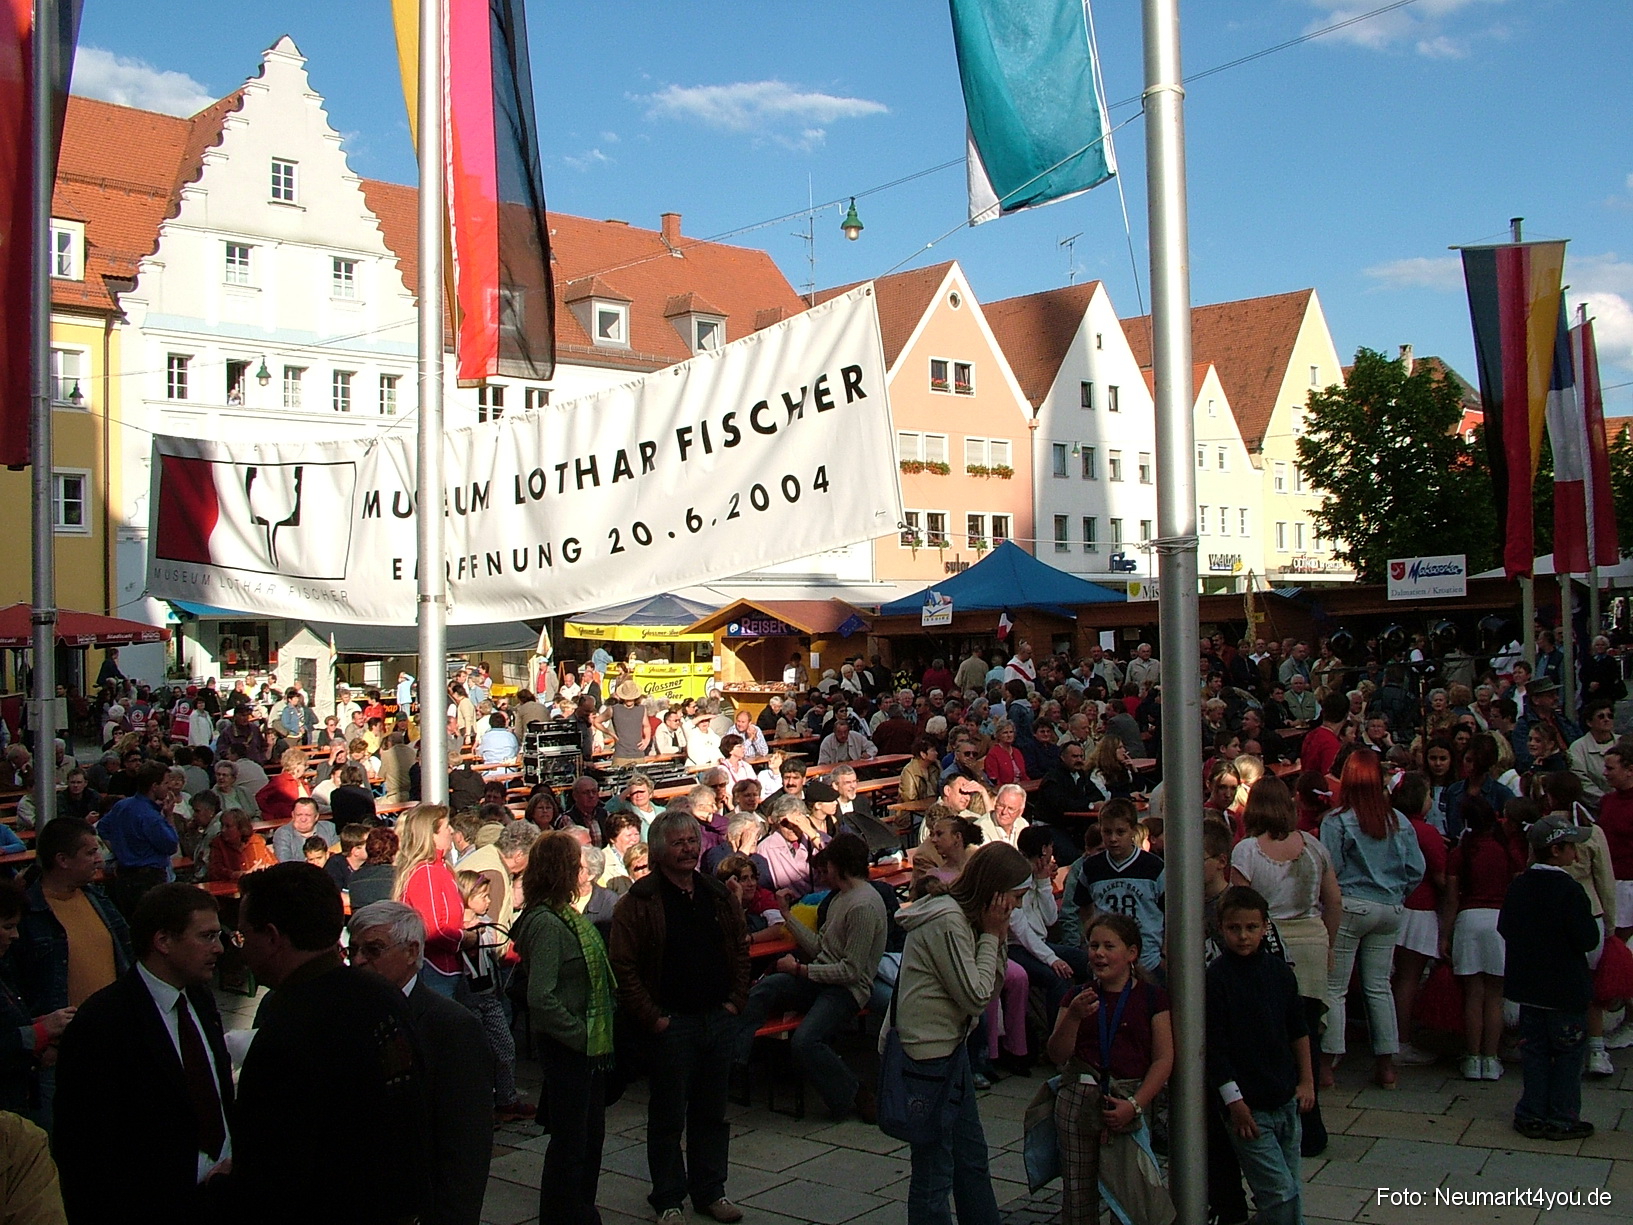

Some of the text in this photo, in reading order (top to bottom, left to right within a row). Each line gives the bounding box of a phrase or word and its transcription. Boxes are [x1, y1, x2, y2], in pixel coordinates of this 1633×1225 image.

[362, 364, 867, 519] MUUM LOTHAR FISCHER
[393, 537, 582, 581] EFFNUNG
[154, 567, 349, 602] MUSEUM LOTHAR FISCHER
[1391, 589, 1426, 597] Dalmatien
[1432, 586, 1463, 595] Kroatien
[740, 617, 787, 633] REISER
[644, 678, 684, 695] Glossner
[665, 690, 684, 700] Bier
[1099, 881, 1144, 900] BASKET BALL
[1105, 894, 1137, 918] 38
